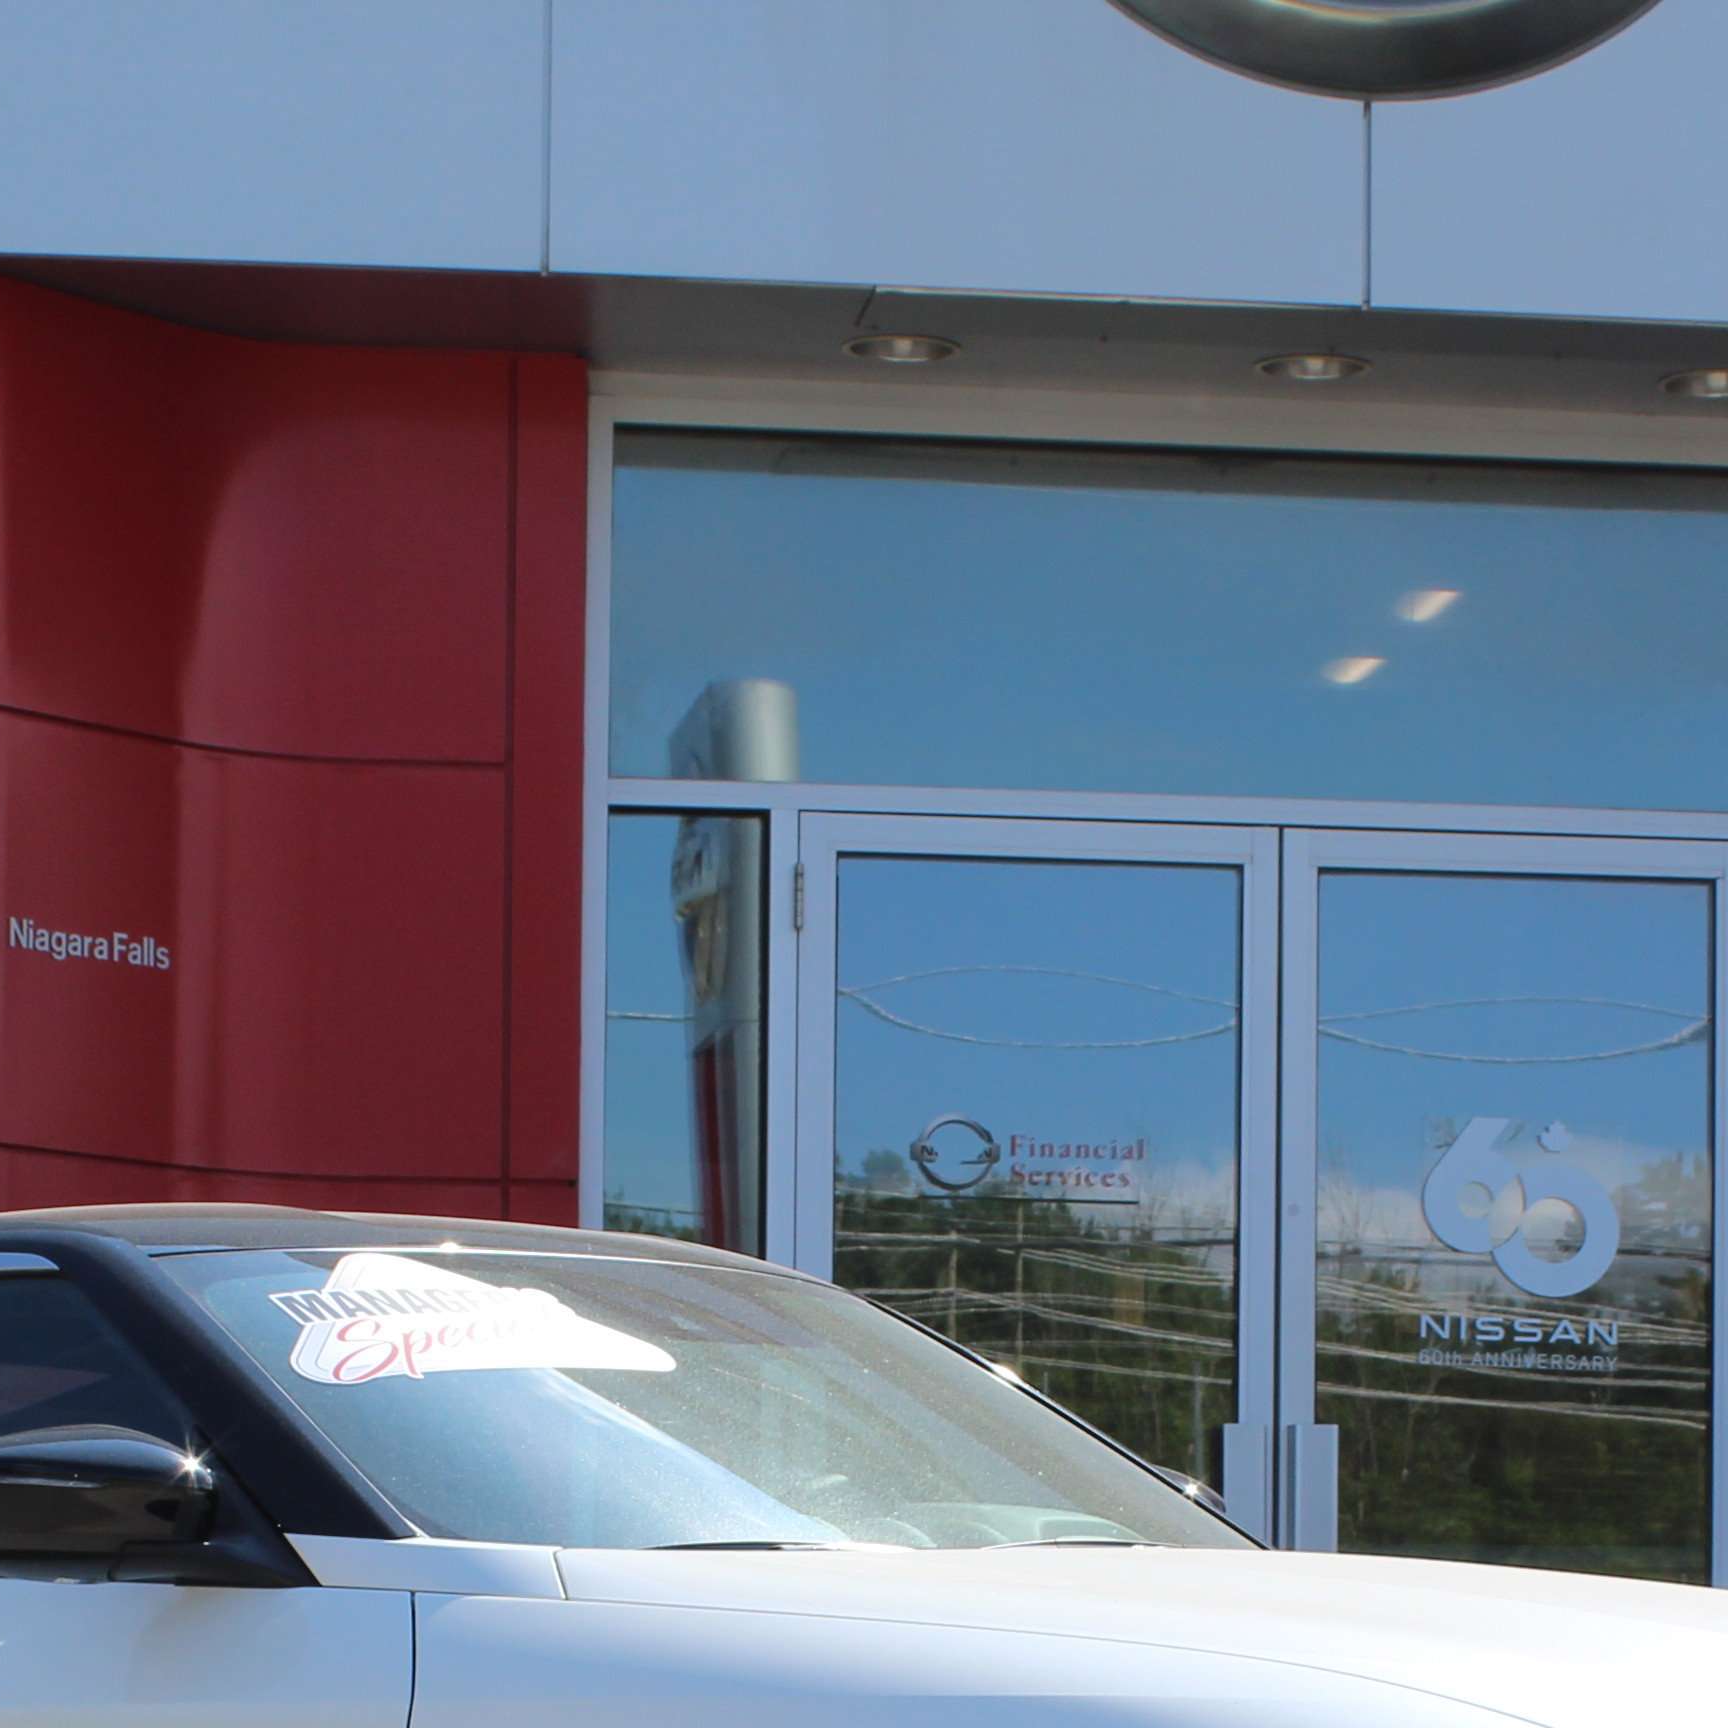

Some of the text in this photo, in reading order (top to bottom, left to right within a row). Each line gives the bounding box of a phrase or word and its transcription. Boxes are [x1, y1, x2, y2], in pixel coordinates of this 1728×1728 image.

[8, 916, 171, 970] Niagara Falls
[1009, 1133, 1147, 1161] Financial
[1009, 1163, 1131, 1189] Services
[1419, 1311, 1619, 1347] NISSAN
[1418, 1348, 1618, 1373] 60th ANNIVERSARY
